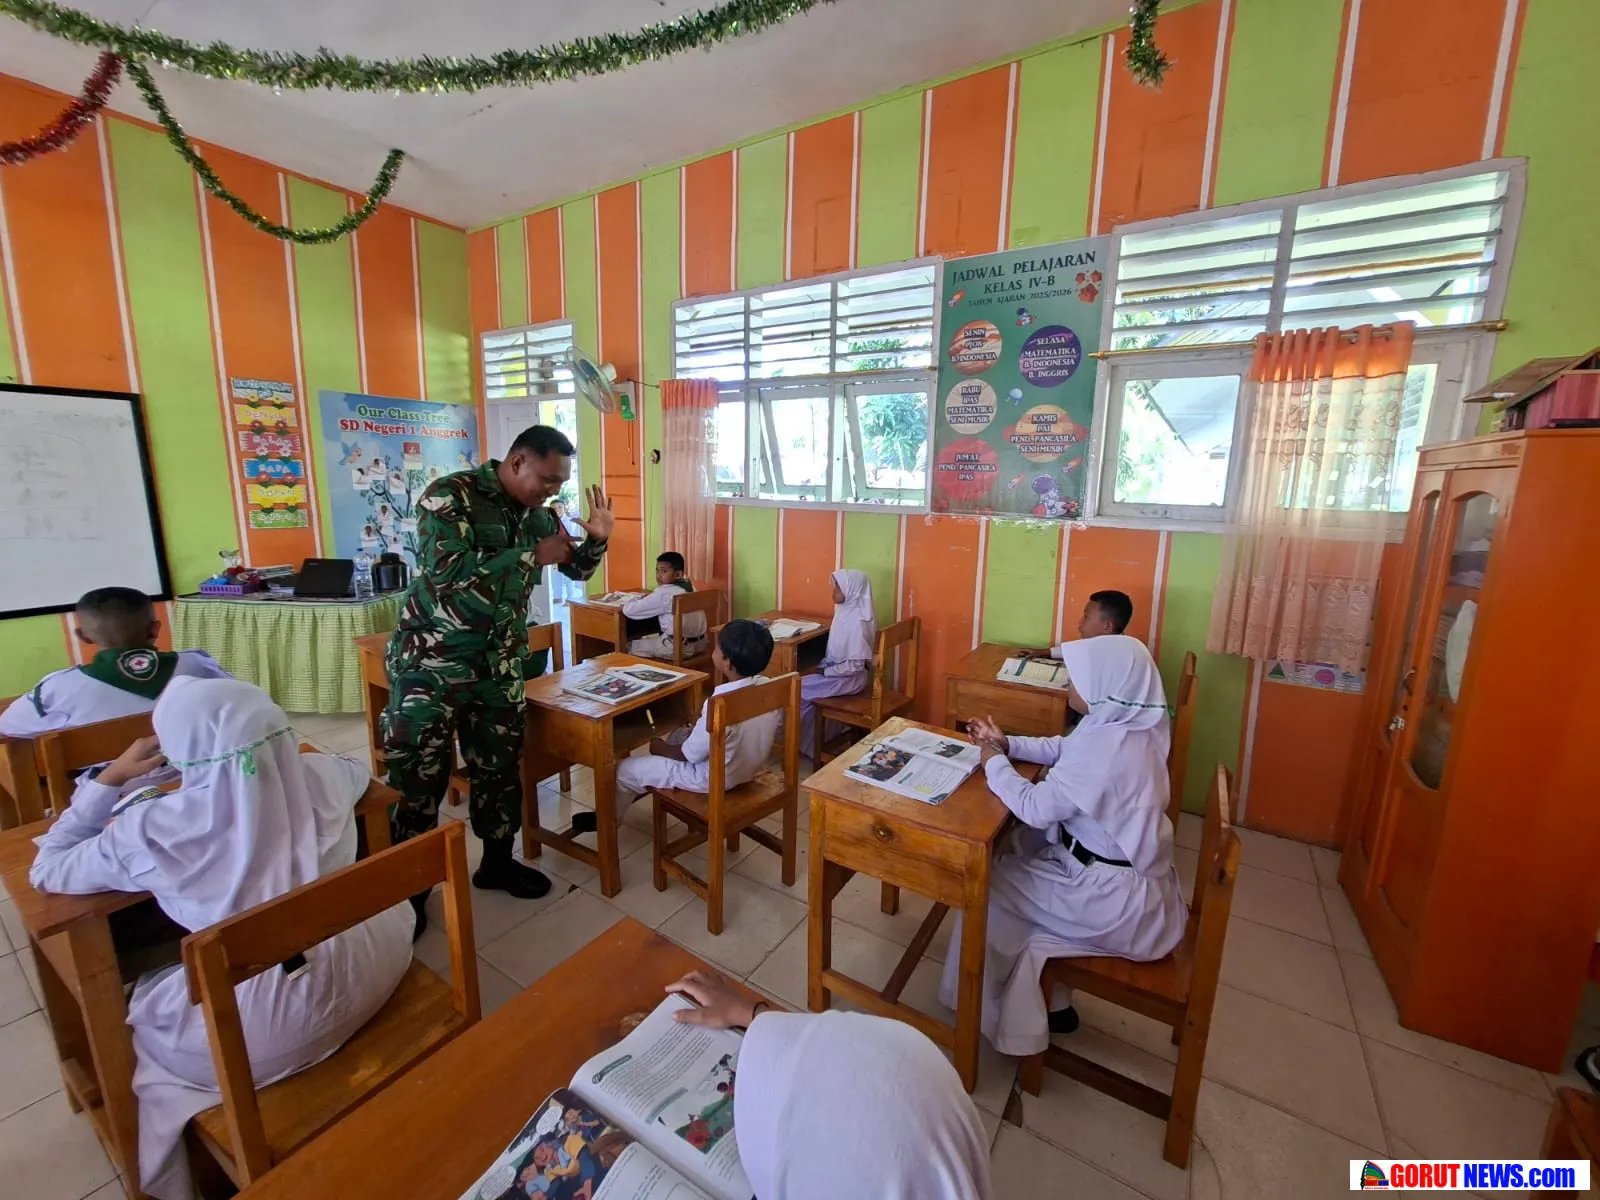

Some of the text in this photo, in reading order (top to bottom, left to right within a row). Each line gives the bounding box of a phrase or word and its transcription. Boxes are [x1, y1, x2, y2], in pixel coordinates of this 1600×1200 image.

[952, 251, 1096, 285] JADWAL PELAJARAN
[984, 275, 1056, 294] KELAS IV-B
[968, 297, 993, 306] TAHUN
[1030, 288, 1072, 300] 2025/2026
[964, 329, 985, 337] SENIN
[1036, 337, 1066, 345] SELASA
[959, 353, 996, 361] INDONESIA
[1024, 348, 1076, 357] MATEMATIKA
[1033, 358, 1075, 367] INDONESIA
[1038, 369, 1069, 377] INGGRIS
[357, 405, 449, 423] Our Class Tree
[947, 406, 993, 414] MATEMATIKA
[340, 419, 359, 430] SD
[363, 420, 406, 435] Negeri
[421, 426, 468, 439] Anggrek
